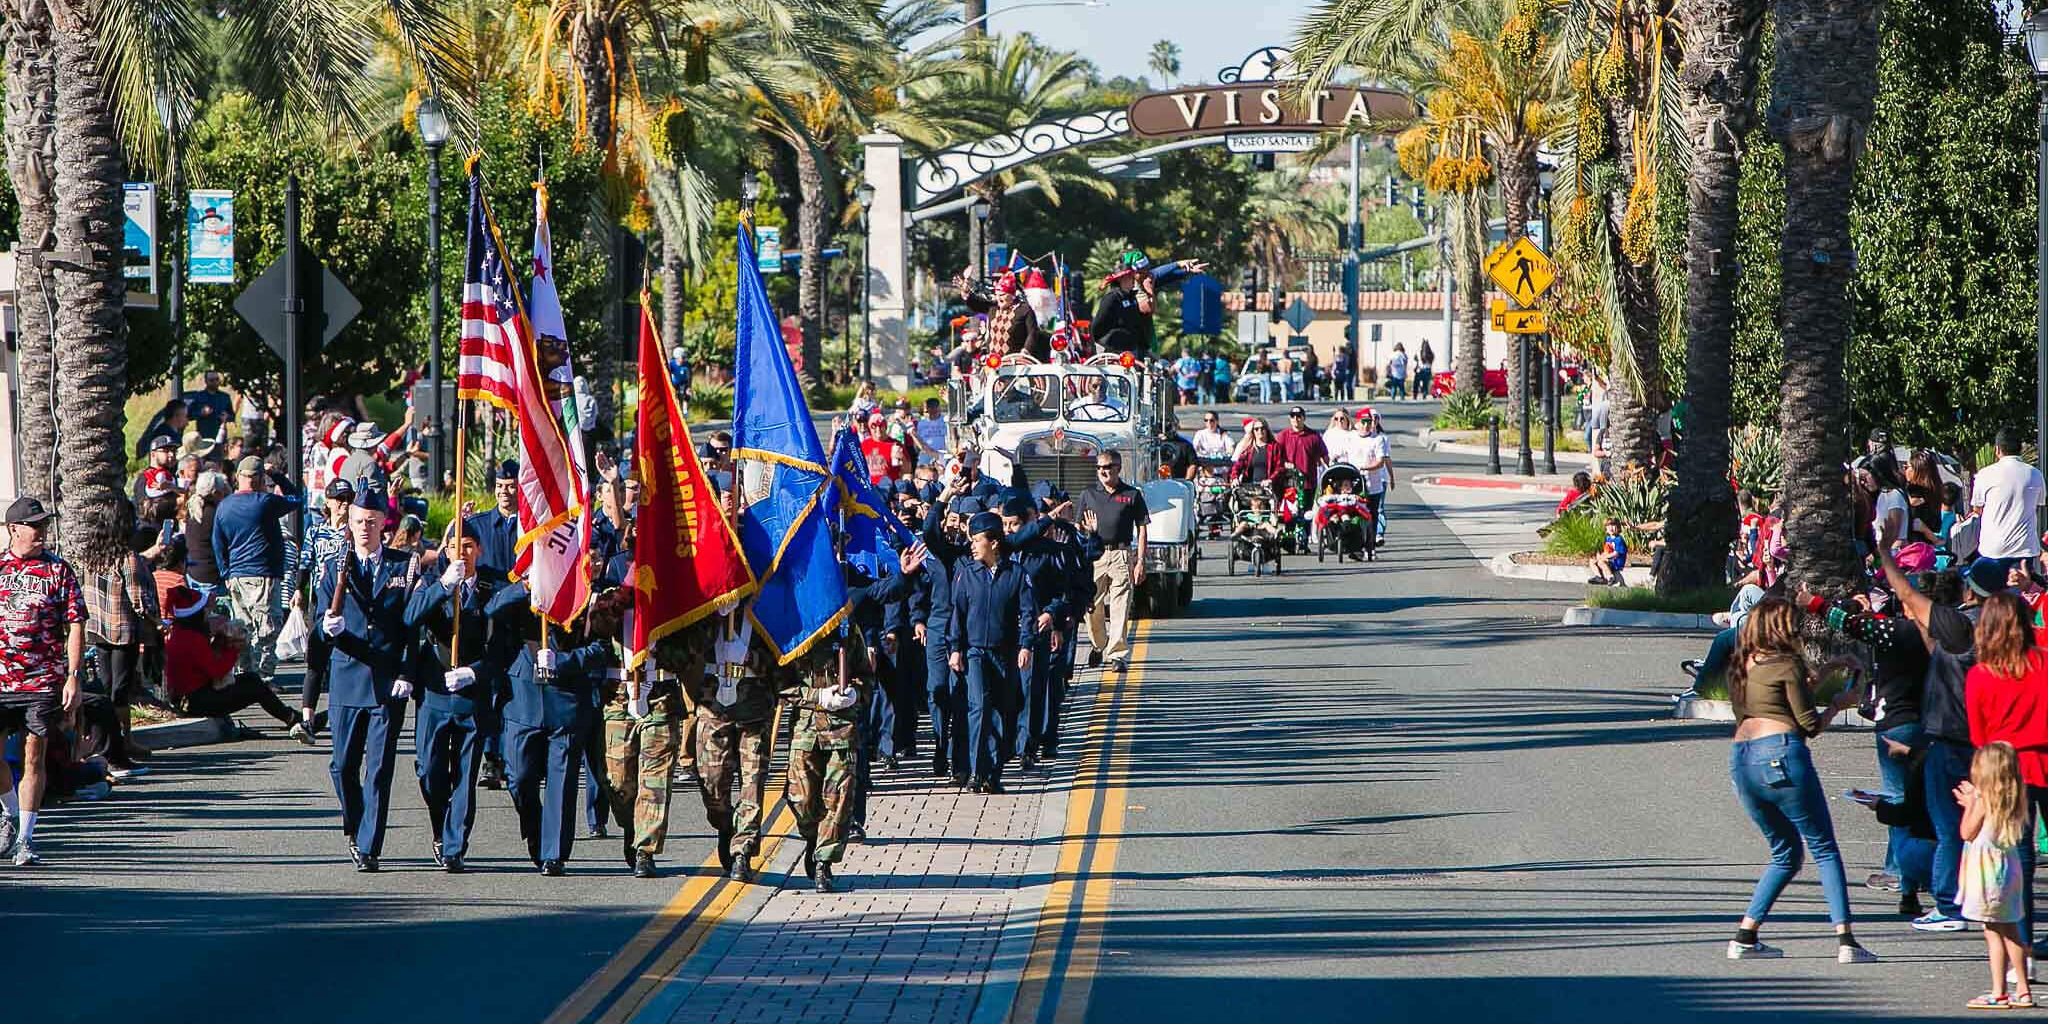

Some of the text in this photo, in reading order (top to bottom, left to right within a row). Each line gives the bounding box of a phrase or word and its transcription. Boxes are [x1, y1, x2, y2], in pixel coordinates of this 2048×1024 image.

[1170, 88, 1373, 128] VISTA
[1270, 136, 1303, 146] SANTA
[664, 445, 698, 558] MARINES
